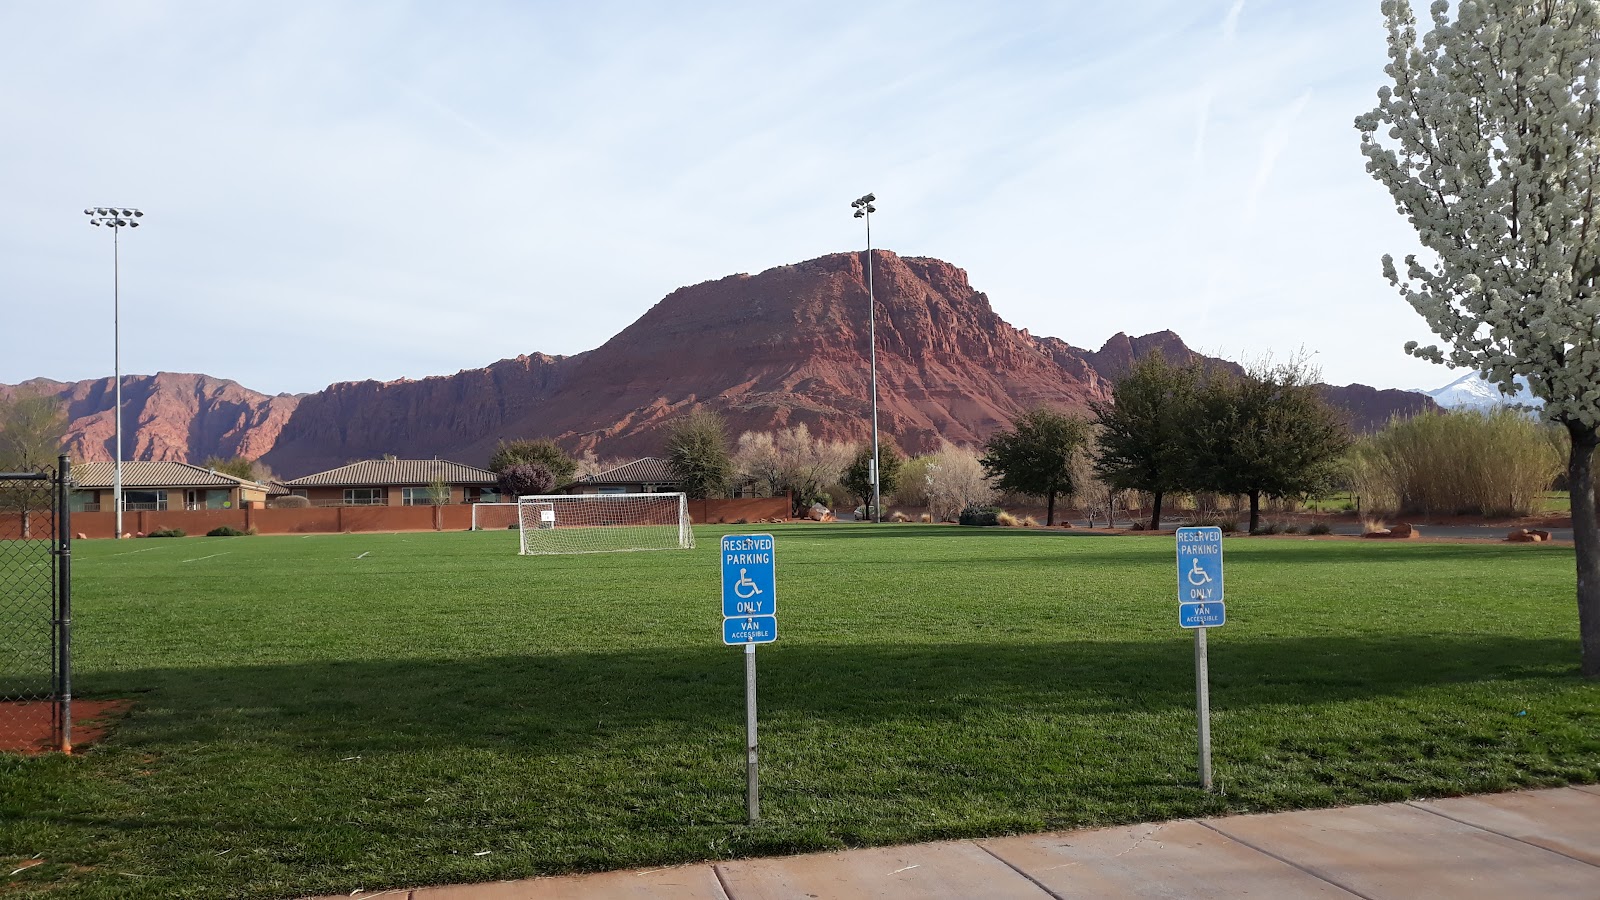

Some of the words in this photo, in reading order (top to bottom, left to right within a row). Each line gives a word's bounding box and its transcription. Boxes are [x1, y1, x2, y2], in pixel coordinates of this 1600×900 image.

[1178, 532, 1220, 542] RESERVED
[724, 540, 772, 550] RESERVED
[1182, 545, 1218, 554] PARKING
[727, 554, 769, 564] PARKING
[1191, 589, 1212, 599] ONLY
[737, 601, 762, 612] ONLY
[741, 622, 759, 630] VAN
